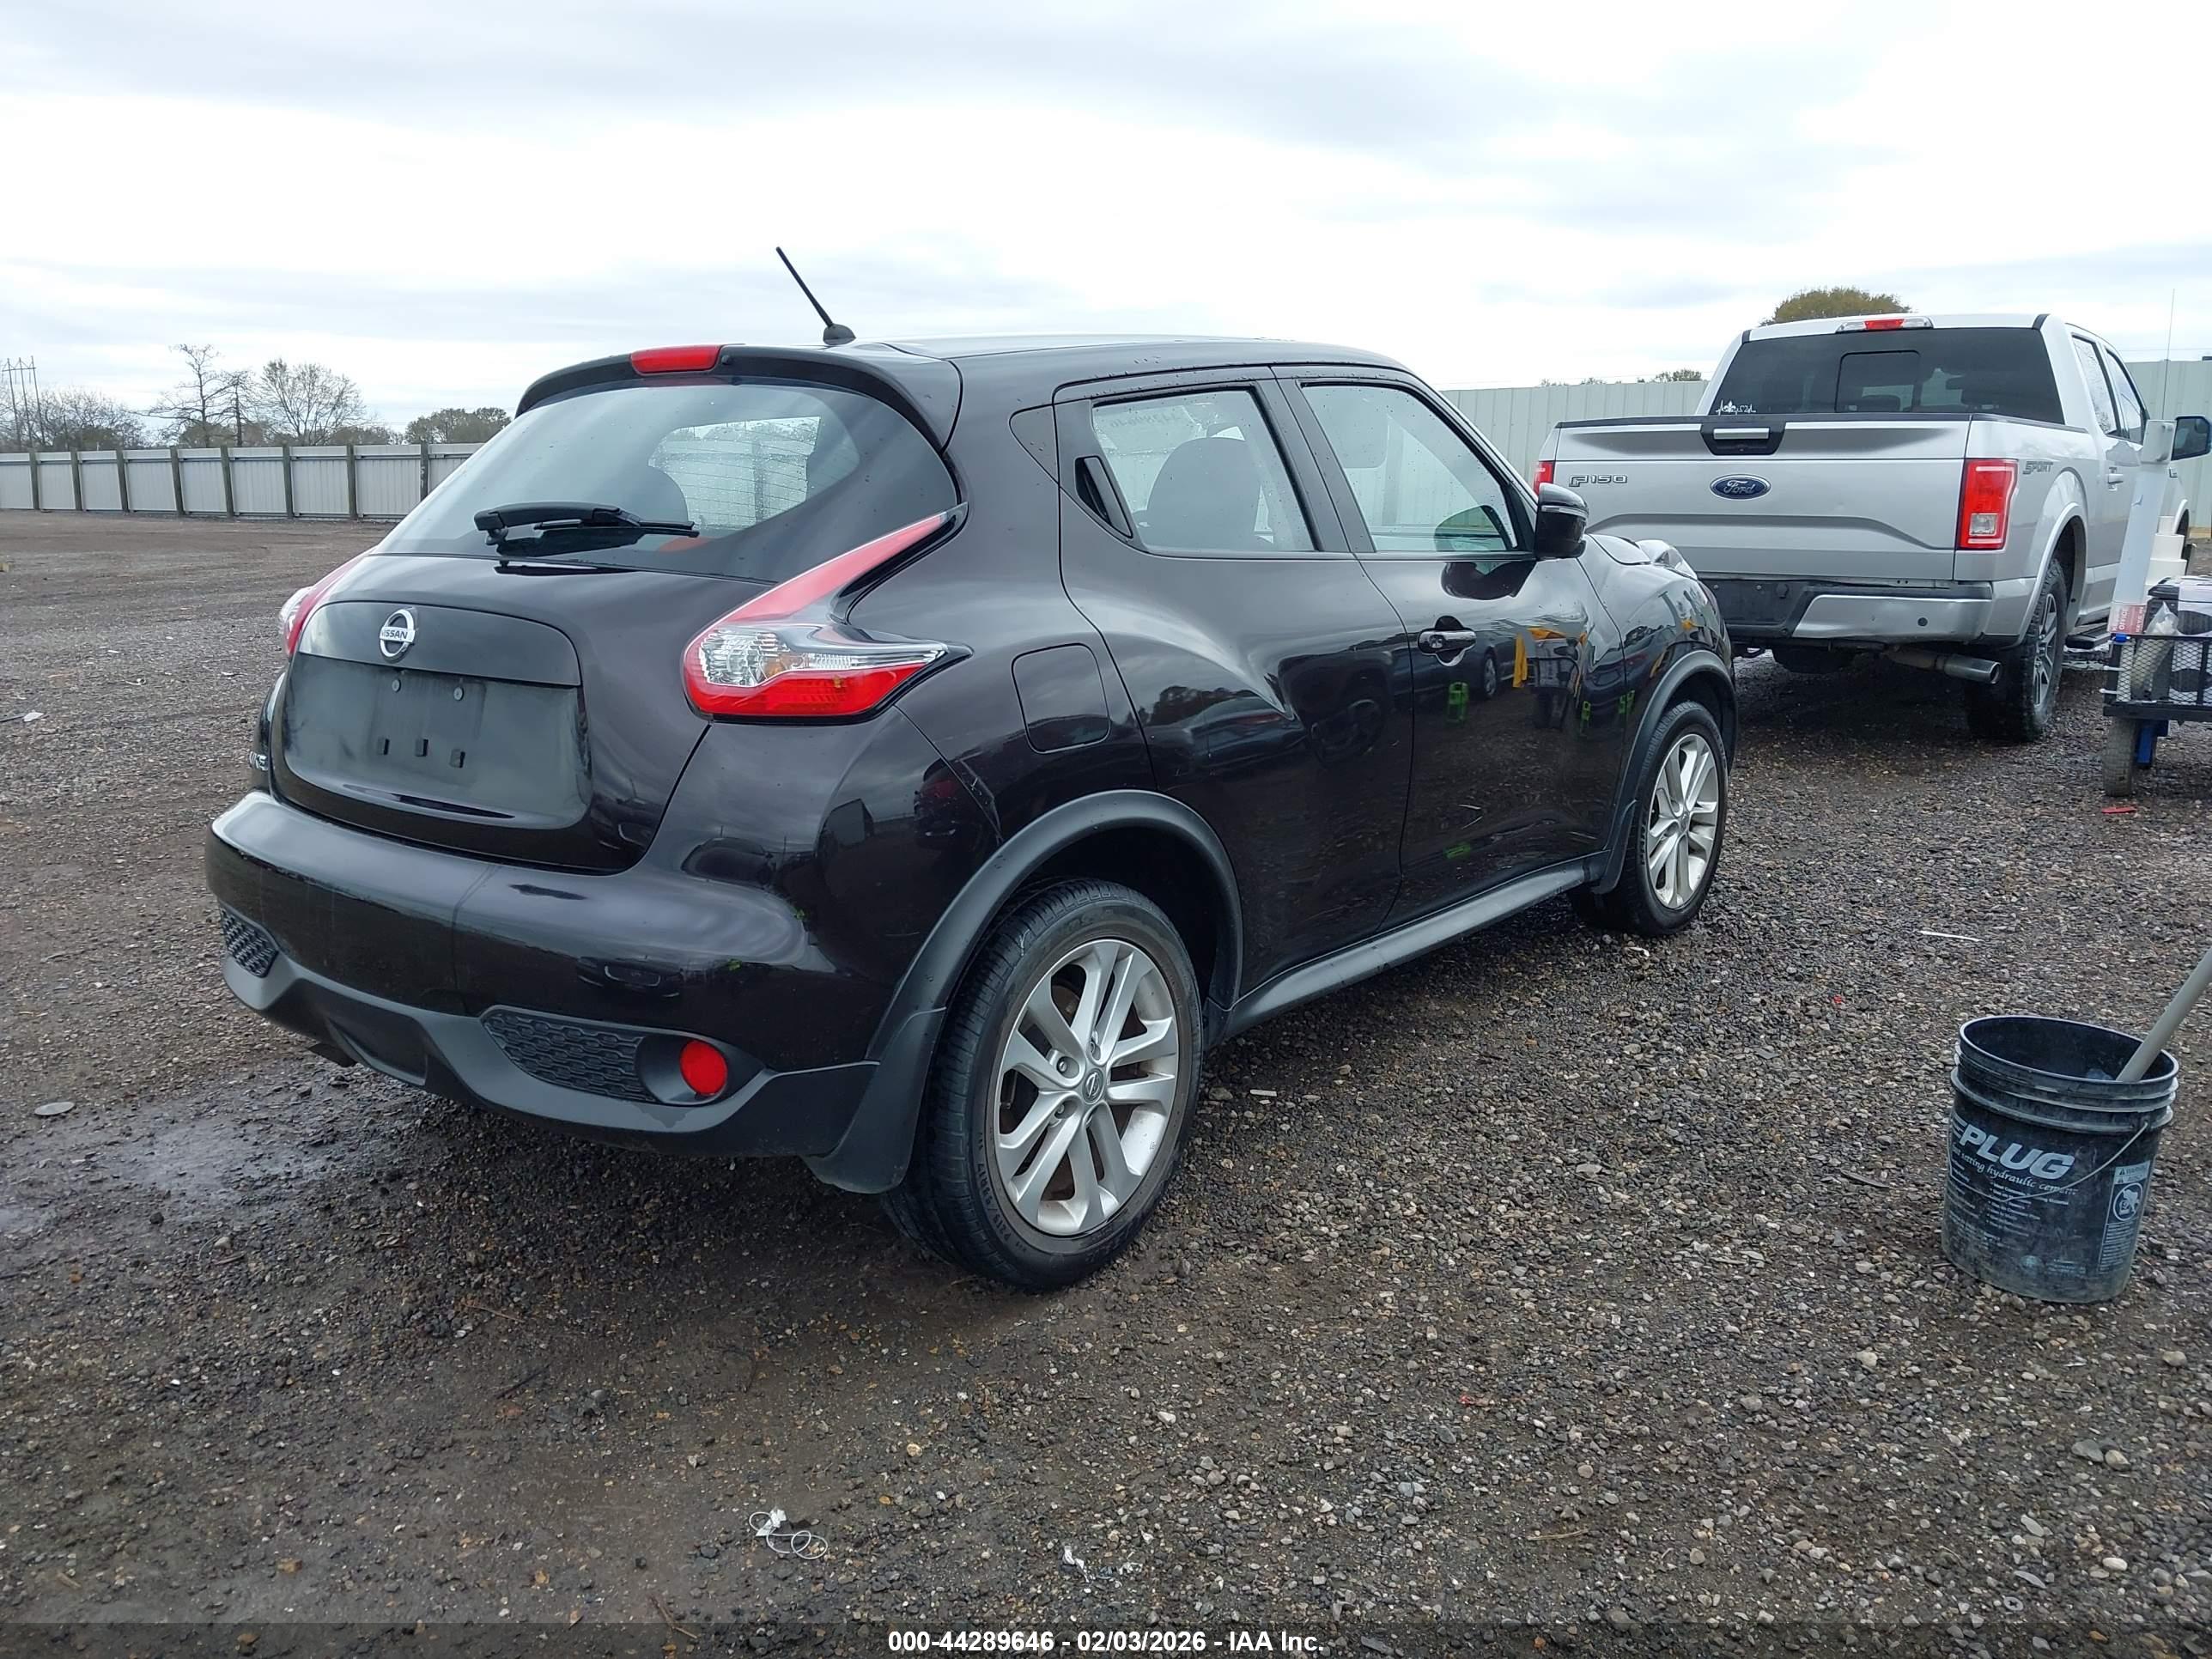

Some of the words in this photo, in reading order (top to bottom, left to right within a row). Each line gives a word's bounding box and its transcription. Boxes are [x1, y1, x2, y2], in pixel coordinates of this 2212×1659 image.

[2022, 460, 2054, 475] SPORT
[1723, 479, 1756, 495] Ford
[1987, 1164, 2037, 1188] hydraulic
